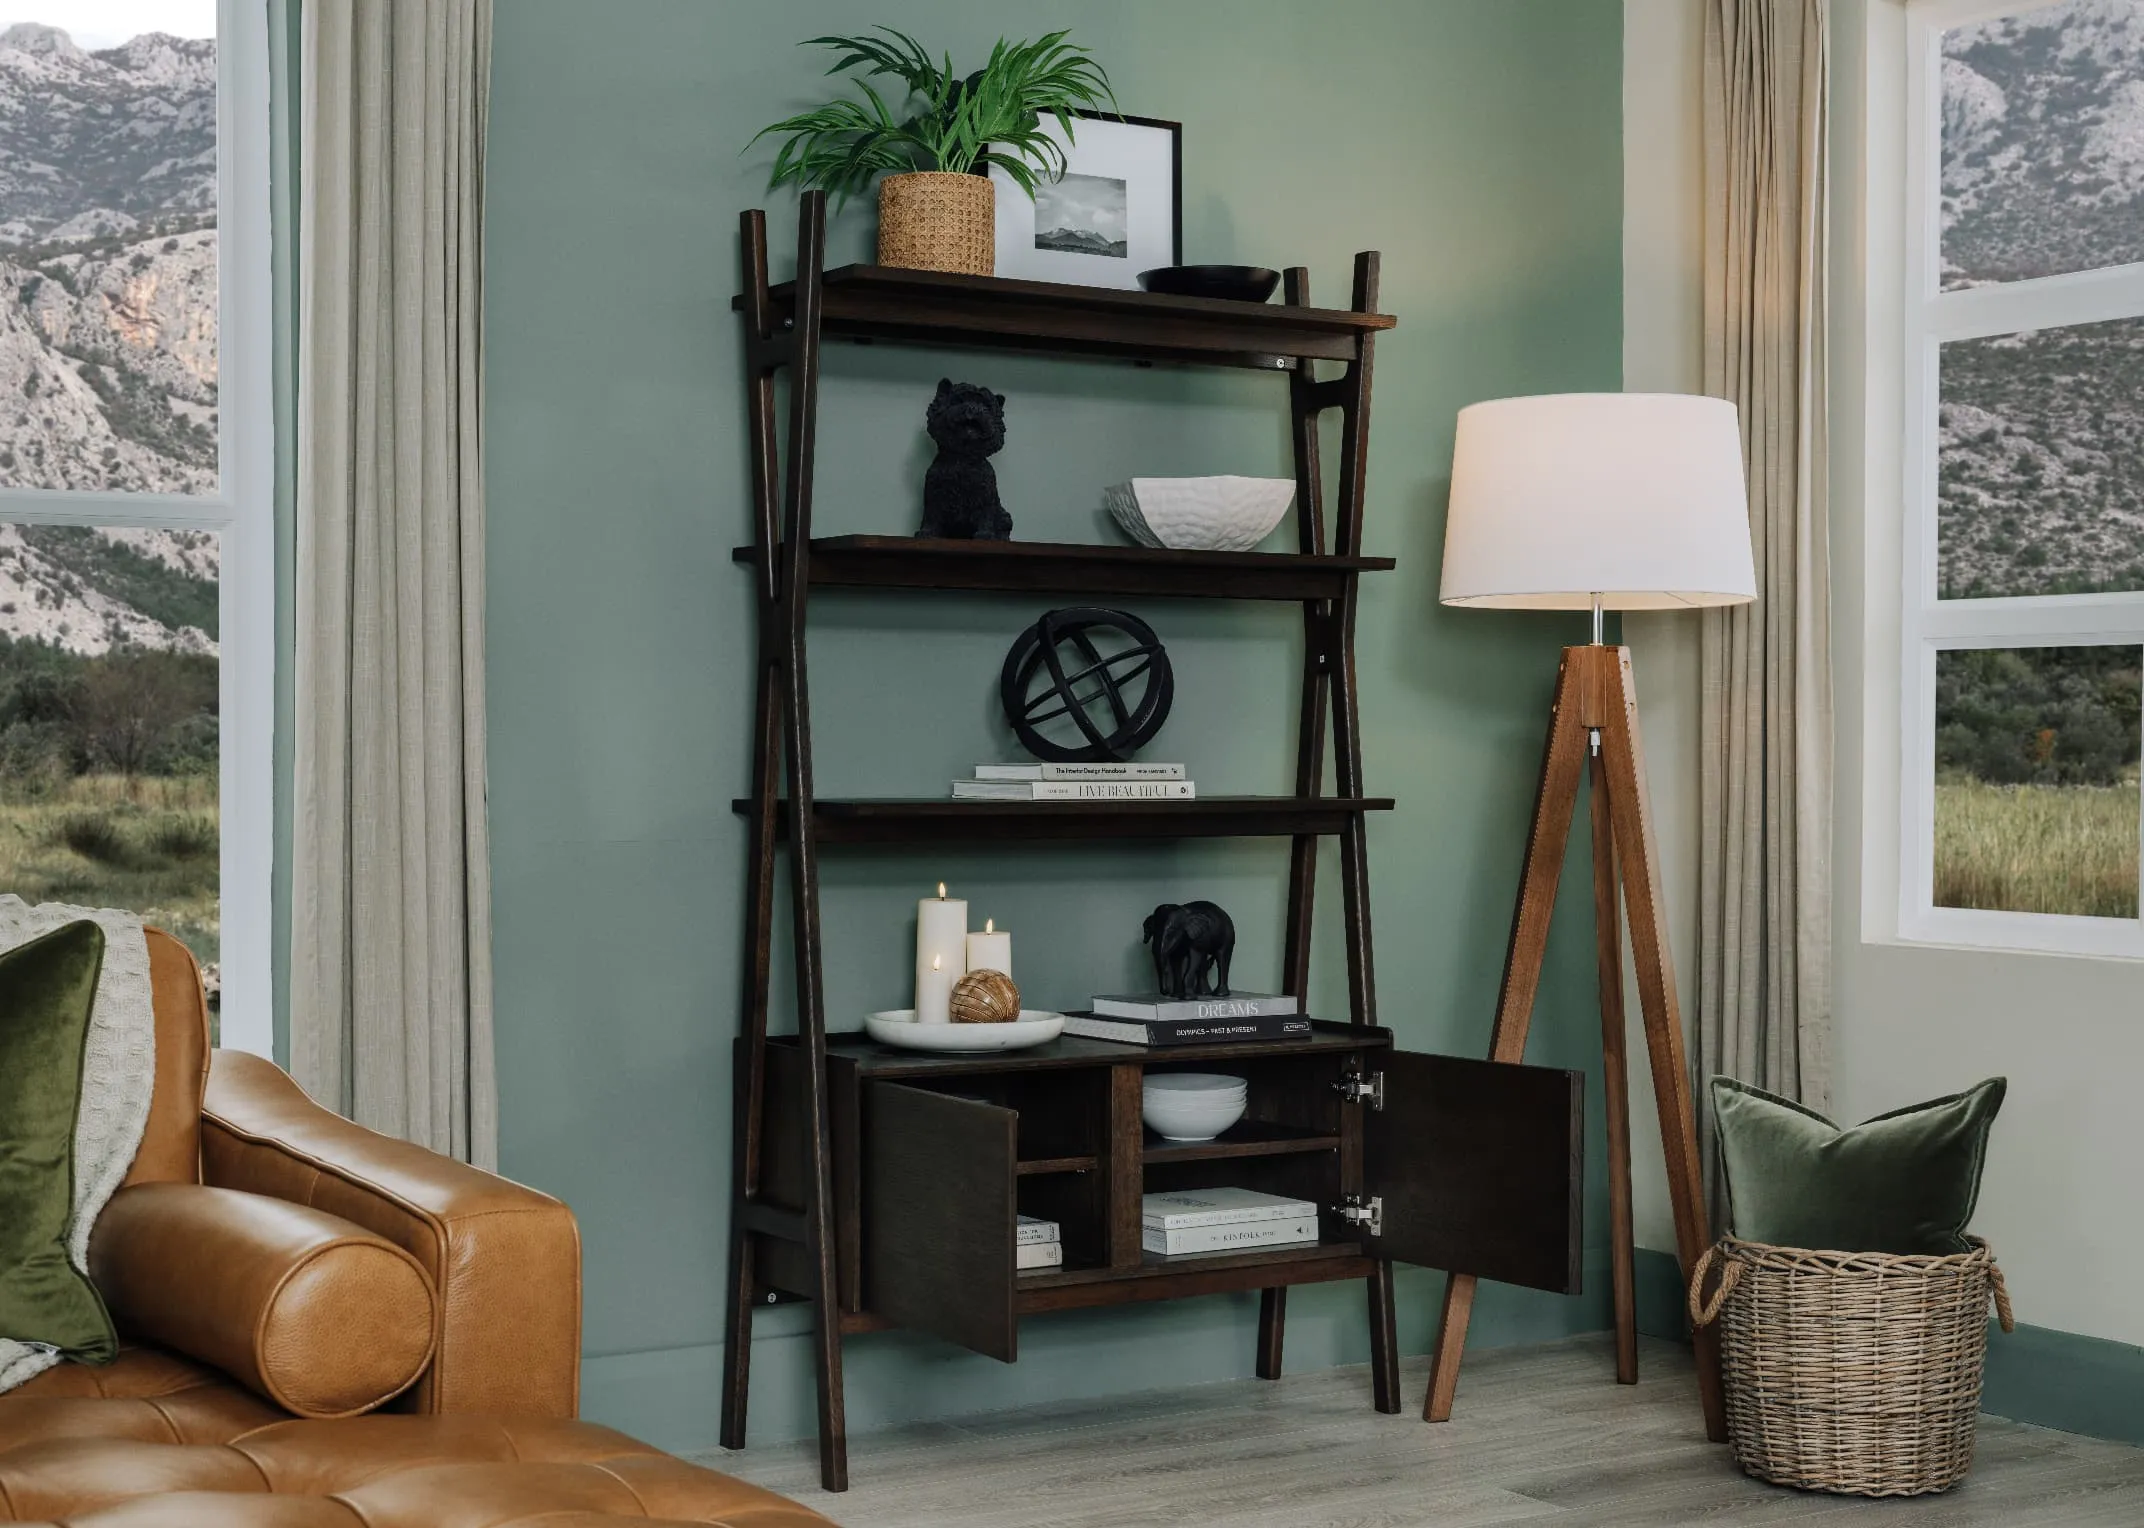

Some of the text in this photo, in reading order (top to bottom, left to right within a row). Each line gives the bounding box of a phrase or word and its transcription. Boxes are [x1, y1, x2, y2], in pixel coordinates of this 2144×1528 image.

[1084, 767, 1101, 775] Design
[1079, 784, 1105, 797] LIVE
[1108, 784, 1170, 797] BEAUTIFUL
[1198, 1002, 1258, 1018] DREAMS
[1176, 1028, 1206, 1037] OLYMPICS
[1210, 1027, 1225, 1035] PAST
[1232, 1025, 1257, 1034] PRESENT
